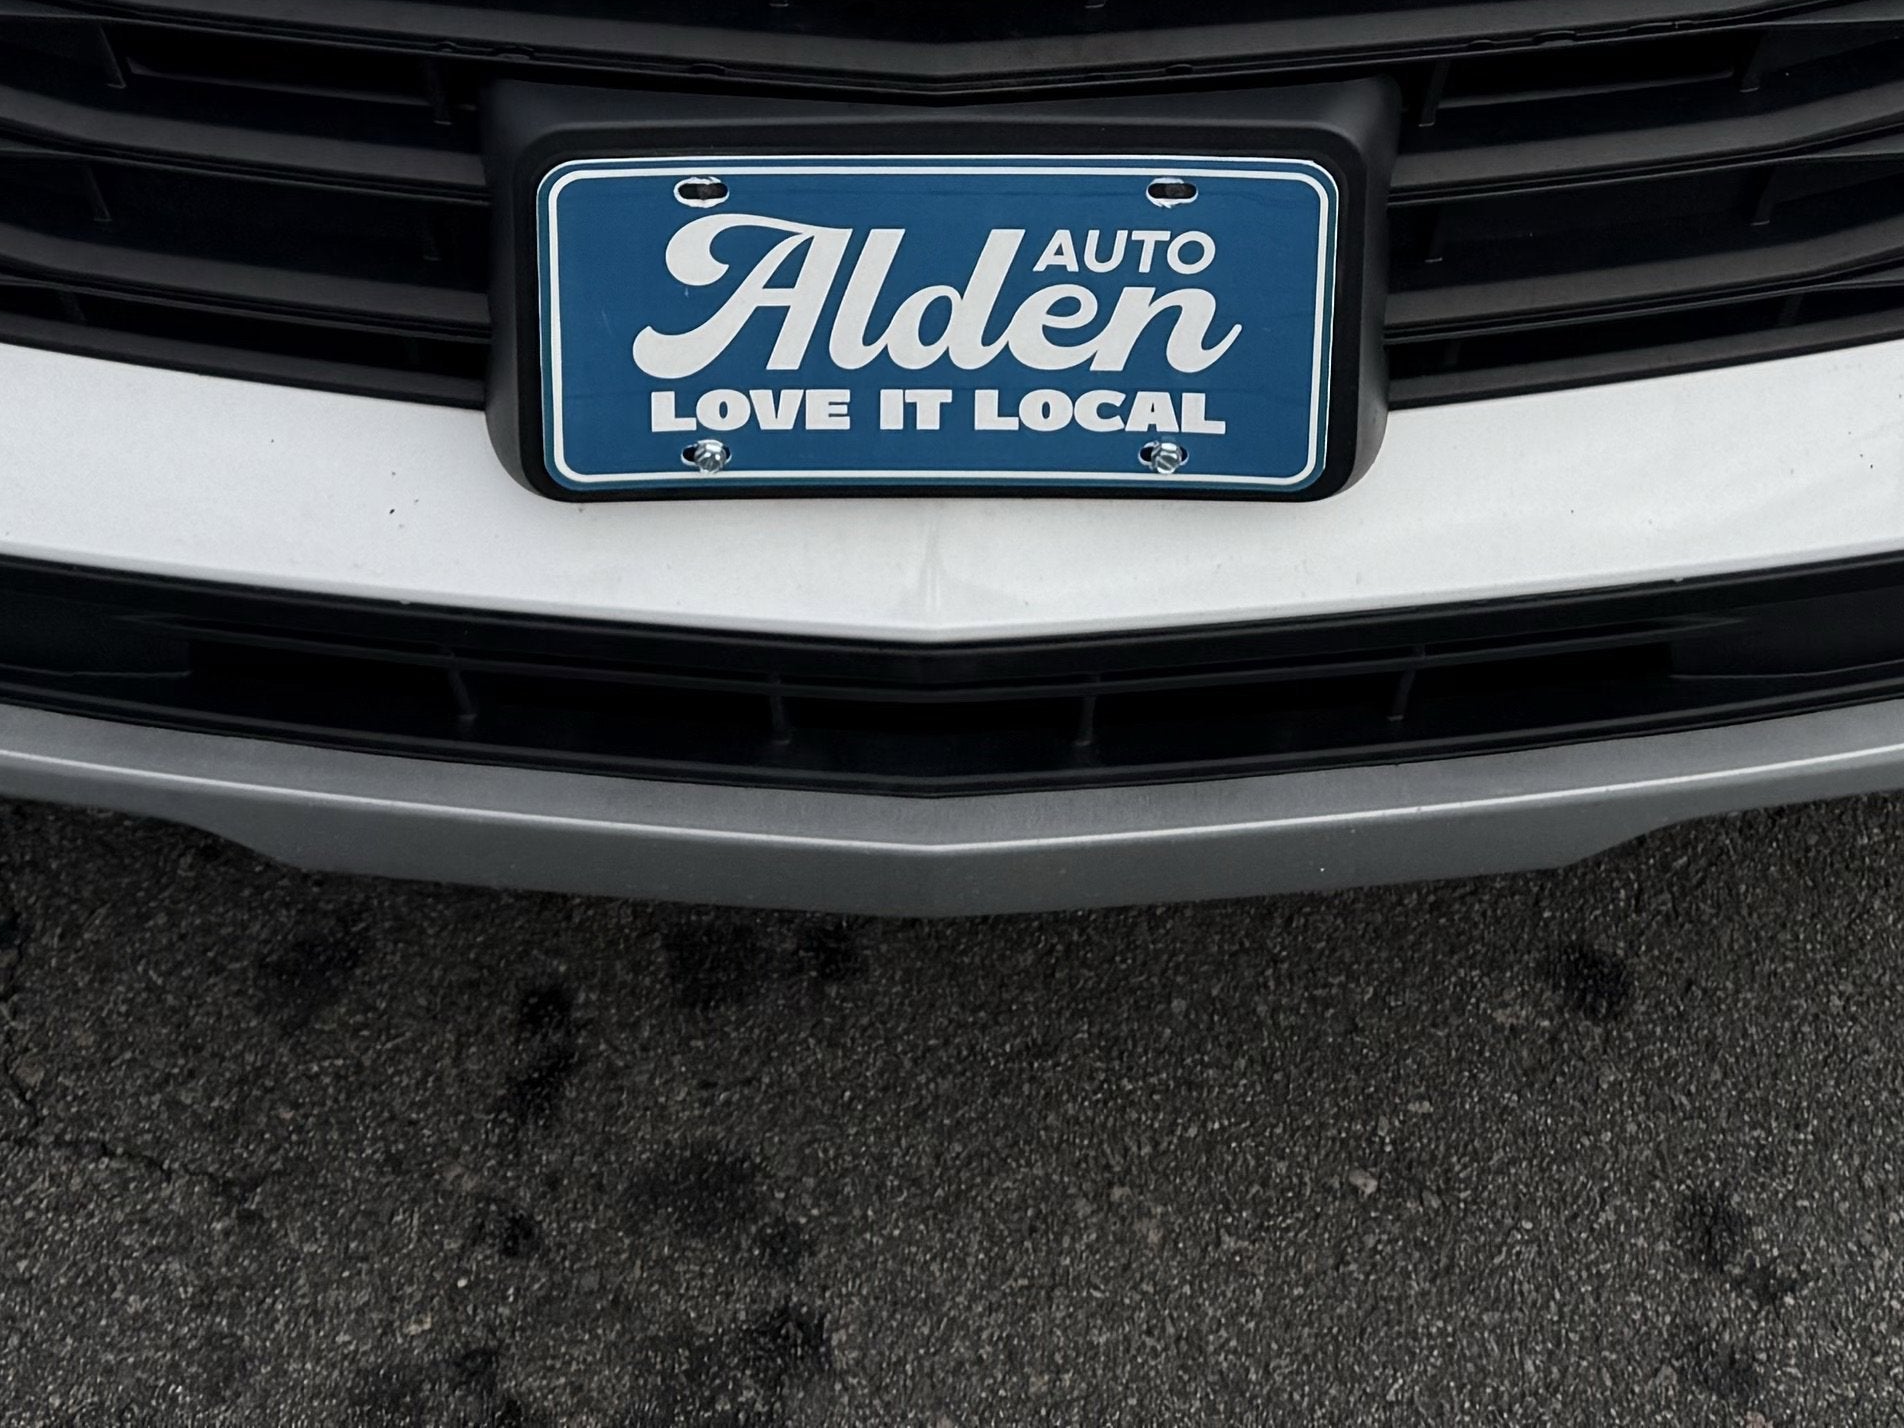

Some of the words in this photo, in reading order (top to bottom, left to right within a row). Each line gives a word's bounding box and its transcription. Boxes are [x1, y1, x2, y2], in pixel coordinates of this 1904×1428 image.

[1032, 229, 1216, 275] AUTO
[632, 213, 1242, 379] Alden
[650, 388, 851, 433] LOVE
[879, 388, 953, 431] IT
[974, 389, 1227, 435] LOCAL
